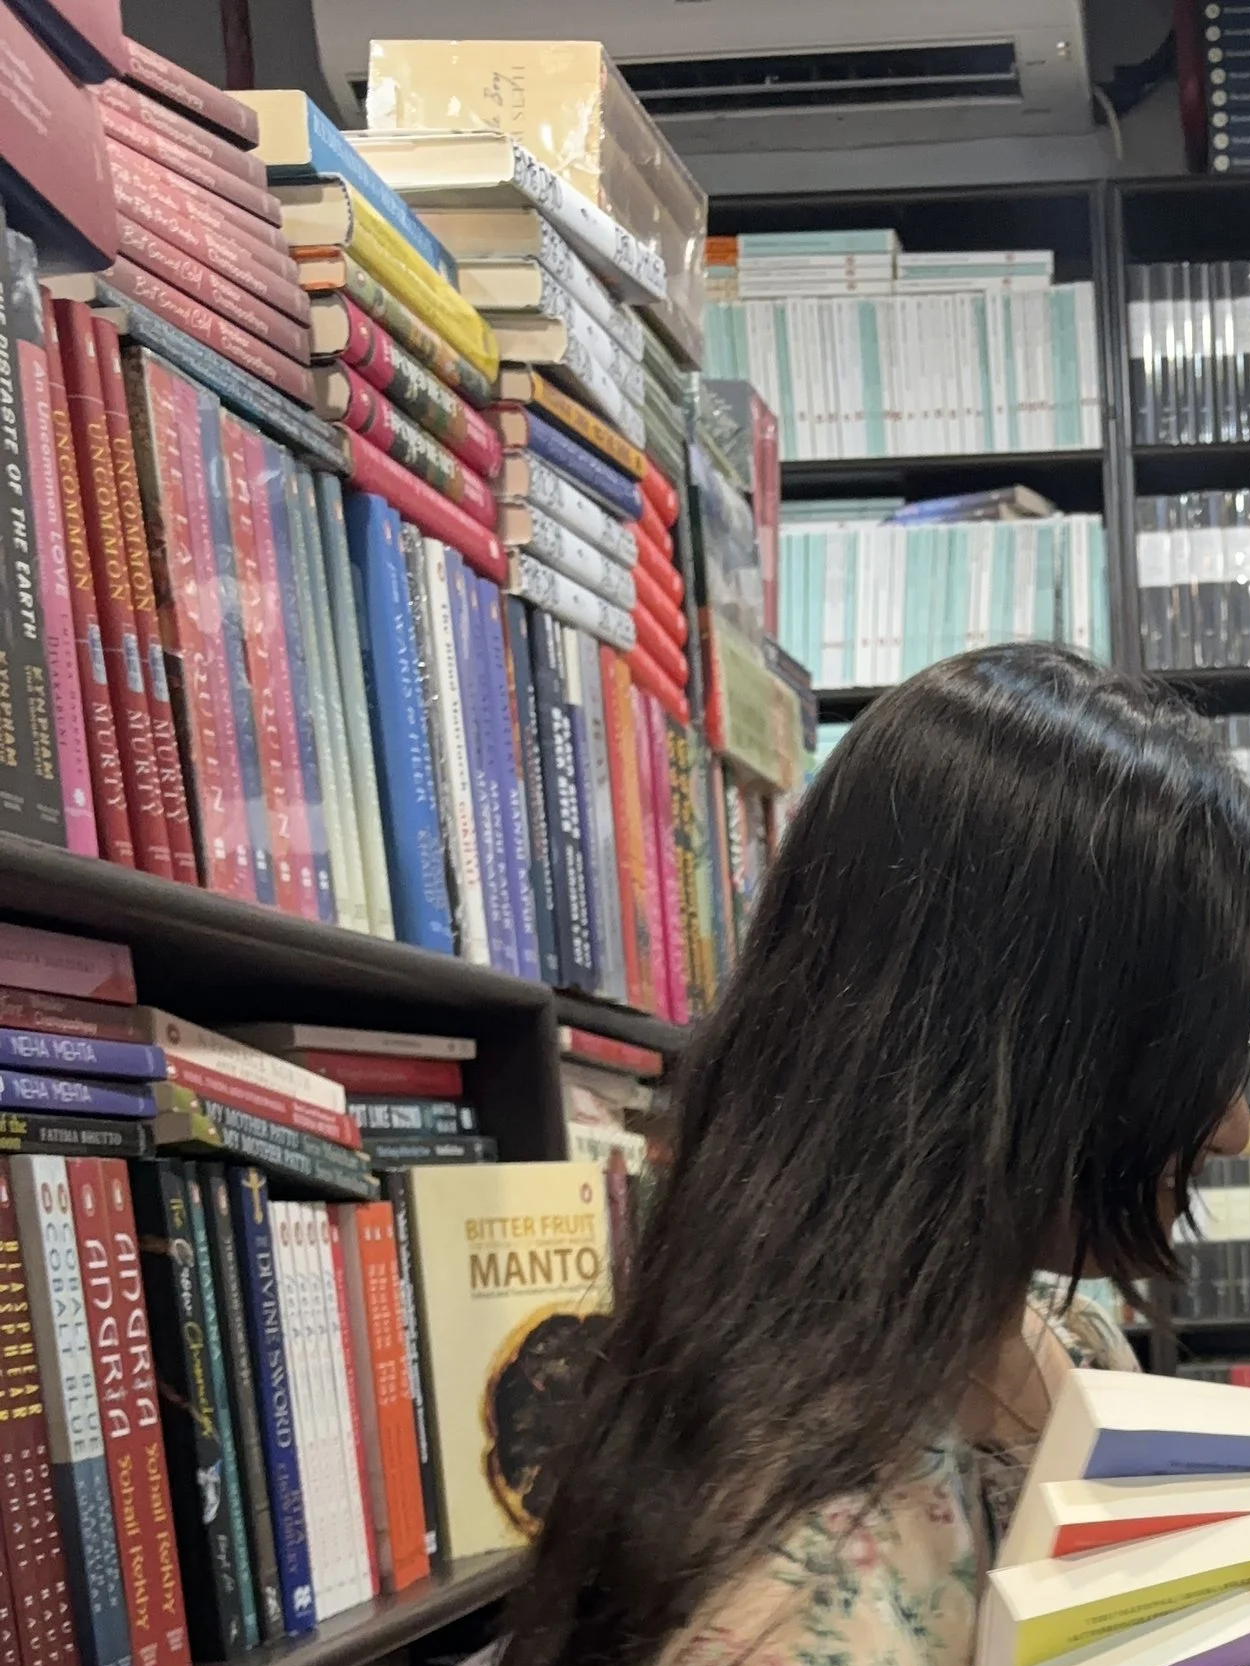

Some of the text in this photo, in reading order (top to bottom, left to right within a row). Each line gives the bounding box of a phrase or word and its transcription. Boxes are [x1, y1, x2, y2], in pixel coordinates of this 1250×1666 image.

[32, 359, 45, 393] An
[48, 530, 70, 597] LOVE
[53, 409, 92, 591] UNCOMMON
[88, 421, 130, 600] UNCOMMON
[5, 464, 37, 640] OF THE EARTH
[113, 436, 153, 611] UNCOMMON
[11, 1037, 96, 1064] NEHA MEHTA
[14, 1080, 92, 1104] NEHA MEHTA
[40, 1128, 77, 1145] FATIMA
[204, 1101, 268, 1140] MY MOTHER
[223, 1130, 280, 1166] MY MOTHER
[465, 1213, 596, 1241] BITTER FRUIT
[469, 1246, 600, 1289] MANTO
[45, 1222, 86, 1454] COBALT BLUE
[61, 1222, 99, 1452] COBALT BLUE
[256, 1253, 292, 1450] DIVINE SWORD
[117, 1454, 141, 1537] Sohail
[145, 1441, 168, 1523] Sohail
